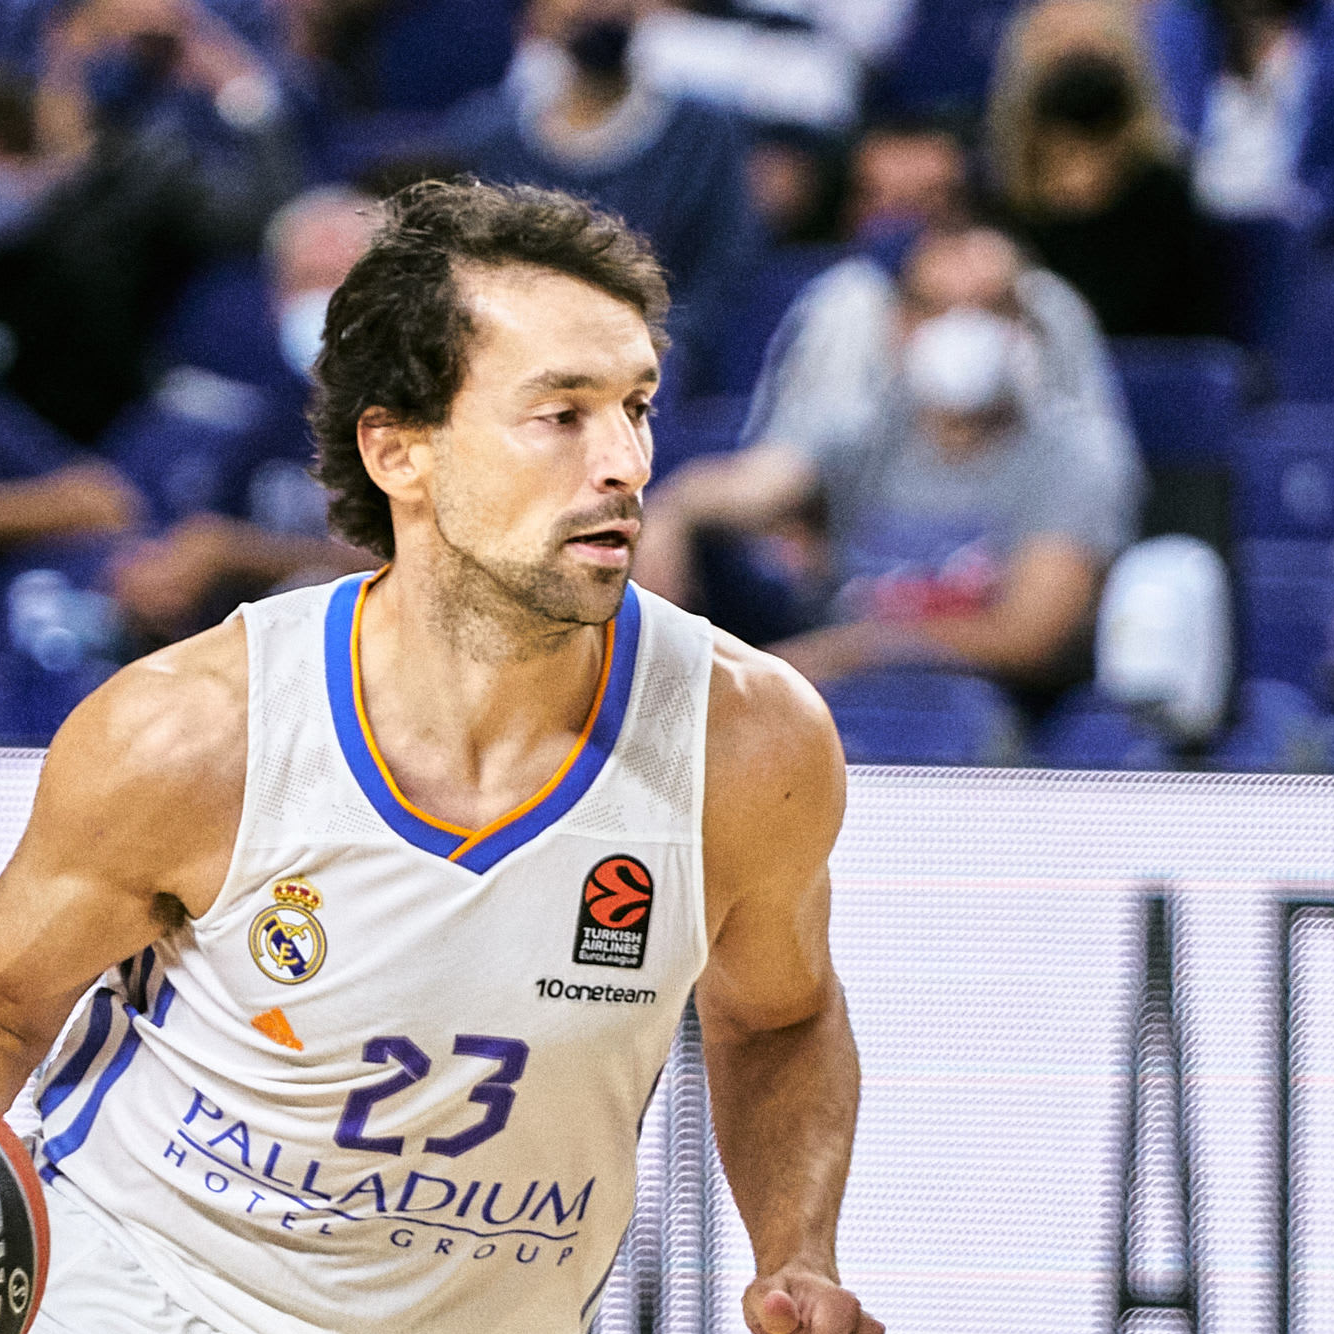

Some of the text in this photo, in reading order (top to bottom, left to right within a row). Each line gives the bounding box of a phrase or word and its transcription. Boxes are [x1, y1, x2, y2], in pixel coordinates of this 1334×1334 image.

[578, 951, 639, 966] EuroLeague
[580, 938, 641, 955] AIRLINES
[582, 926, 643, 944] TURKISH
[333, 1033, 530, 1159] 23
[182, 1087, 597, 1228] PALLADIUM
[163, 1141, 575, 1268] HOTEL GROUP
